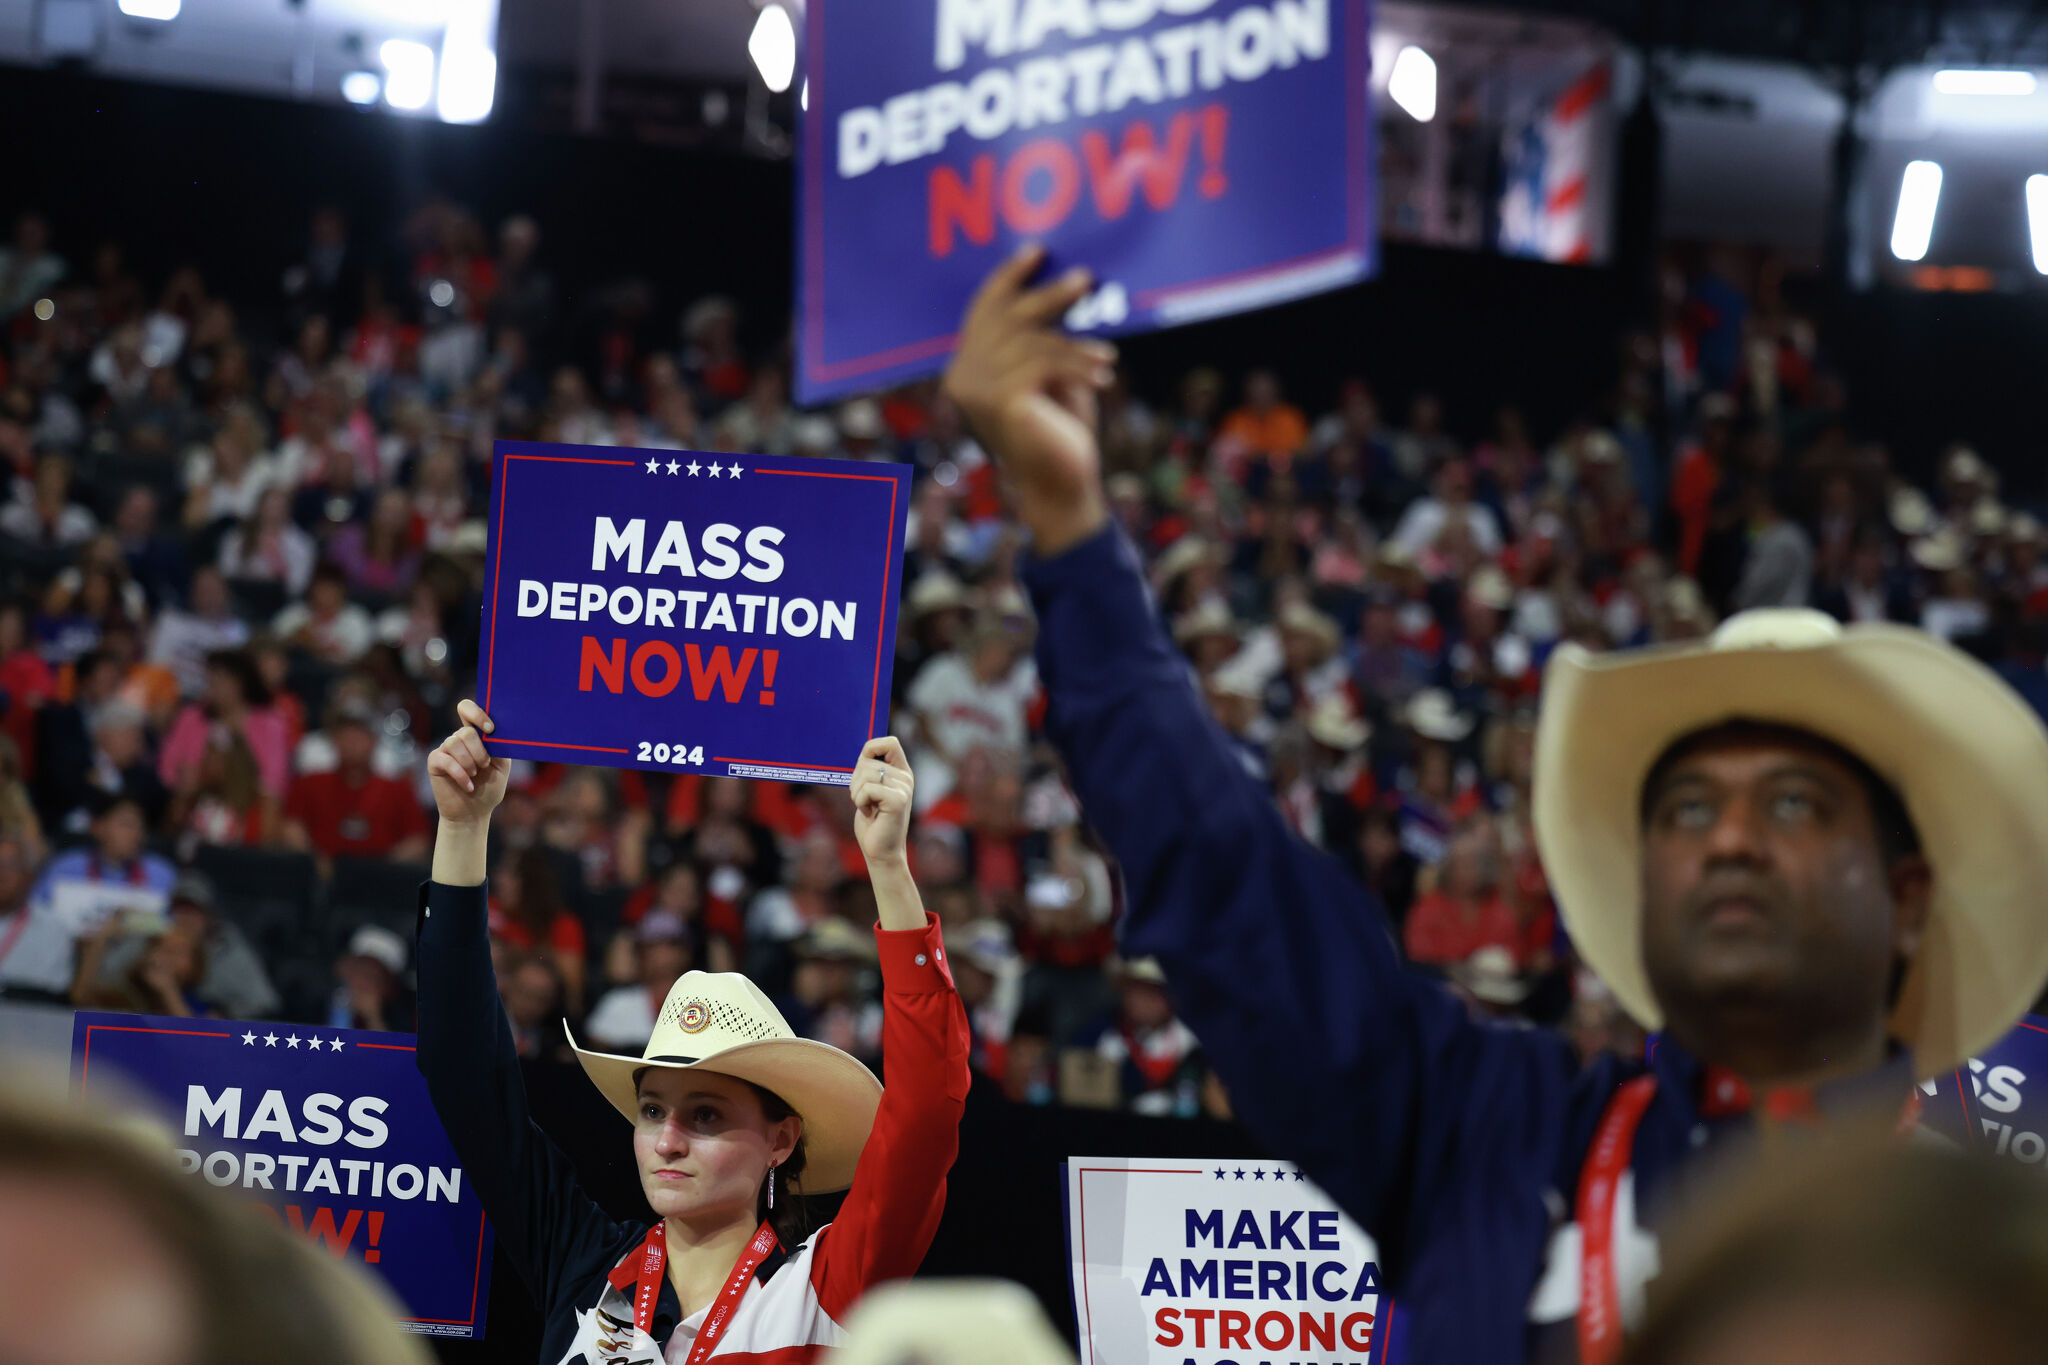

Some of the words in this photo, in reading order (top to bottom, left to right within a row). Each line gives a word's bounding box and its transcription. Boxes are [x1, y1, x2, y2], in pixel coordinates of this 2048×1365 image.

[837, 0, 1329, 178] DEPORTATION
[927, 103, 1229, 258] NOW!
[592, 516, 786, 583] MASS
[517, 580, 857, 640] DEPORTATION
[578, 636, 779, 706] NOW!
[636, 742, 705, 765] 2024
[184, 1084, 390, 1149] MASS
[172, 1148, 462, 1204] PORTATION
[1185, 1208, 1340, 1251] MAKE
[644, 1255, 653, 1275] TRUST
[1140, 1257, 1380, 1302] AMERICA
[706, 1304, 728, 1338] RNC2024
[1155, 1307, 1375, 1353] STRONG
